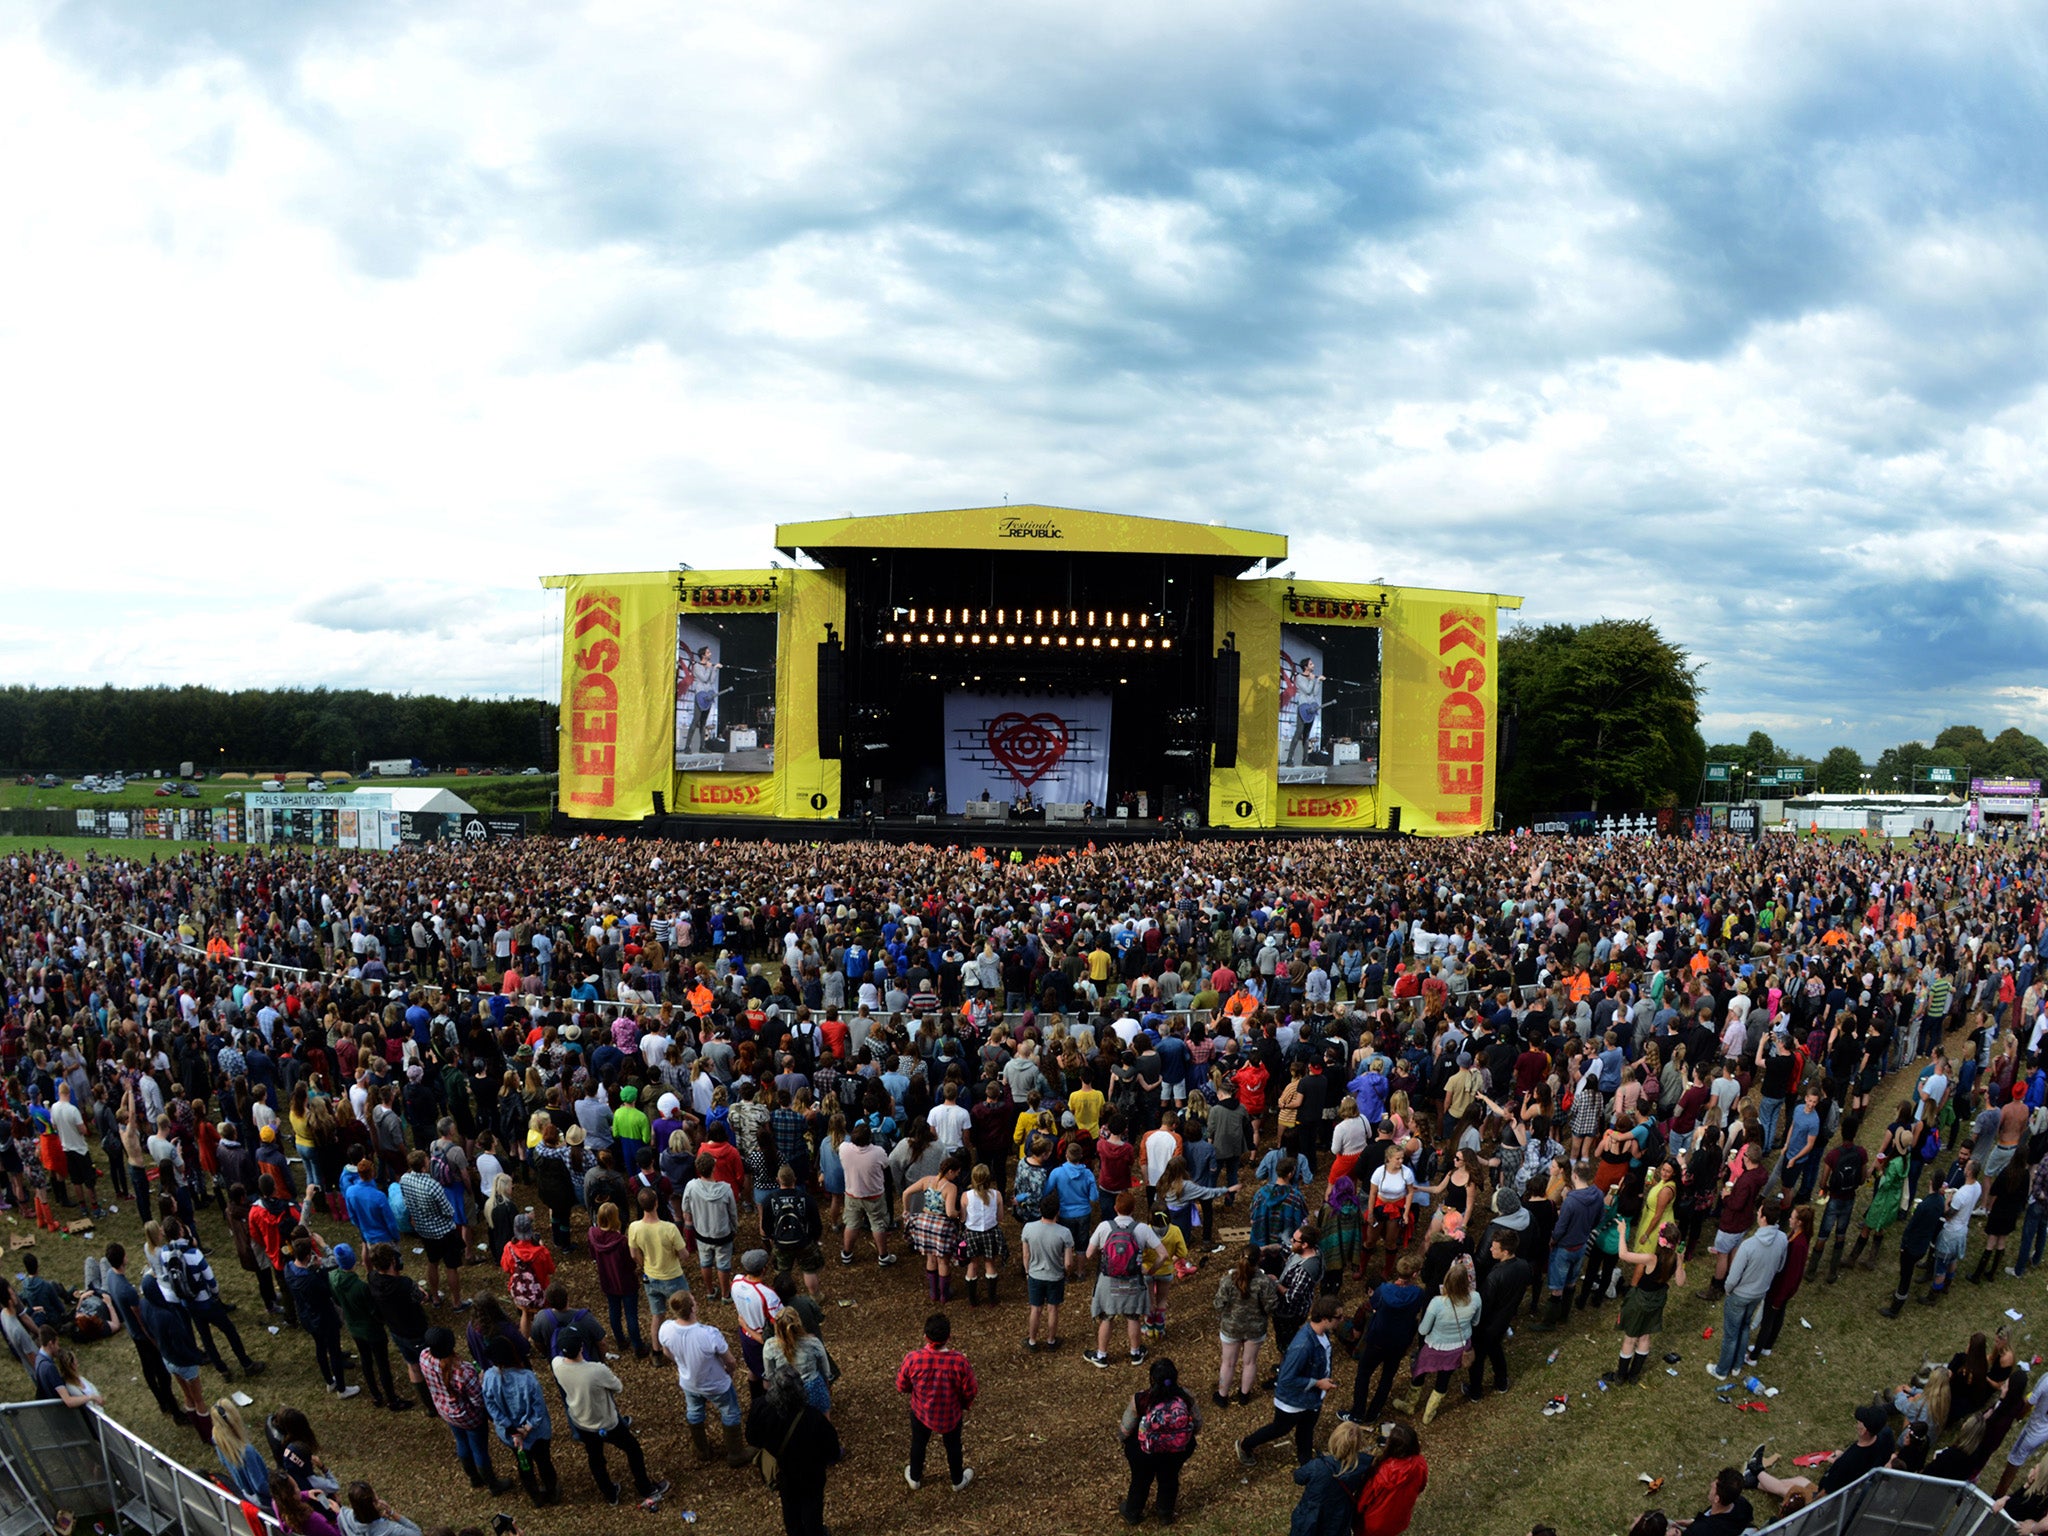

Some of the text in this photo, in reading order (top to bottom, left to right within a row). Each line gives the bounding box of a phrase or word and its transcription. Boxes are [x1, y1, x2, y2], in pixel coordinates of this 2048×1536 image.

[999, 517, 1052, 530] Festival
[570, 637, 620, 807] LEEDS
[1436, 657, 1486, 825] LEEDS
[255, 795, 278, 805] FOALS
[280, 795, 302, 805] WHAT
[304, 795, 324, 805] WENT
[325, 795, 347, 805] DOWN
[690, 785, 745, 804] LEEDS
[1287, 799, 1343, 817] LEEDS
[401, 813, 413, 823] City
[401, 823, 413, 831] and
[401, 831, 421, 840] Colour
[1125, 937, 1131, 949] 9
